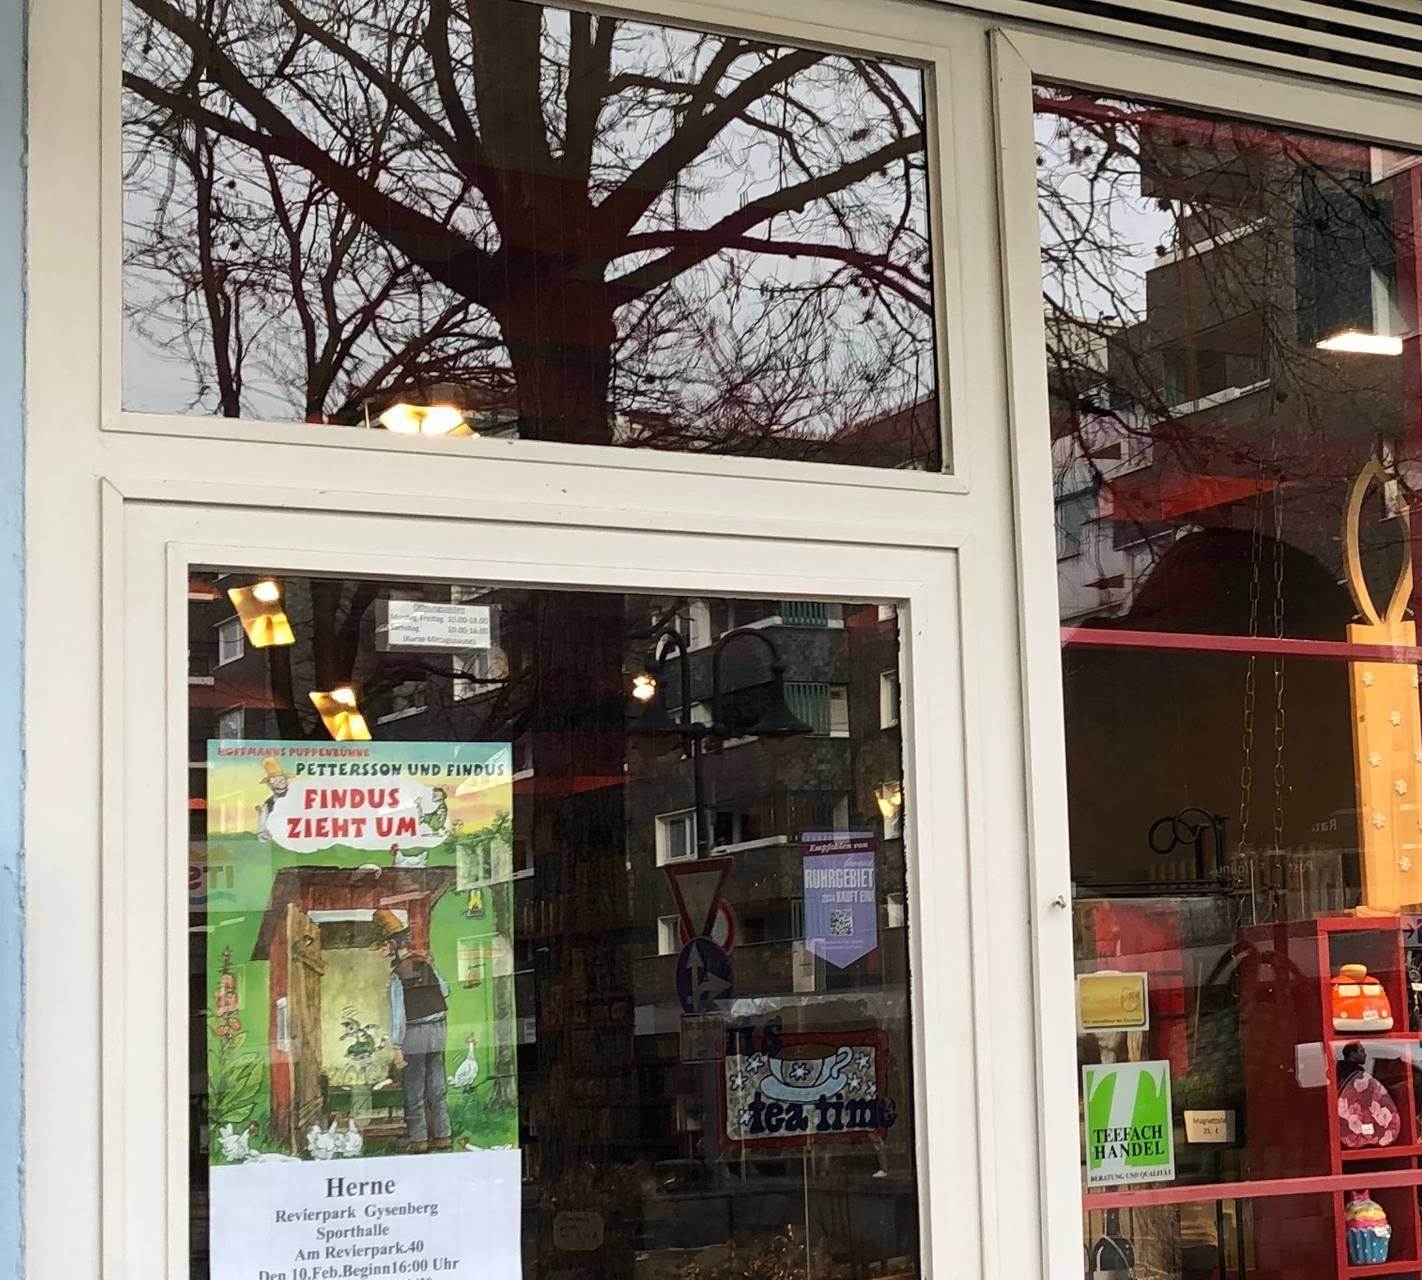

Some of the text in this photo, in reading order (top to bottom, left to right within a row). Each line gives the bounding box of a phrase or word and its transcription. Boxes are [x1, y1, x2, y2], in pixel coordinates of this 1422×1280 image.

[296, 762, 505, 777] PETTERSSON UND FINDUS
[304, 788, 400, 810] FINDUS
[287, 816, 417, 838] ZIEHT UM
[804, 868, 875, 889] RUHRGEBIET
[748, 1092, 898, 1134] tea time
[1093, 1124, 1163, 1144] TEEFACH
[1094, 1141, 1165, 1160] HANDEL
[1090, 1173, 1124, 1182] BERATUNG
[1125, 1171, 1139, 1179] UND
[325, 1177, 396, 1198] Herne
[275, 1202, 439, 1223] Revierpark Gysenberg
[316, 1224, 390, 1242] Sporthalle
[294, 1249, 320, 1261] Am
[258, 1270, 286, 1280] Den
[433, 1257, 460, 1271] Uhr
